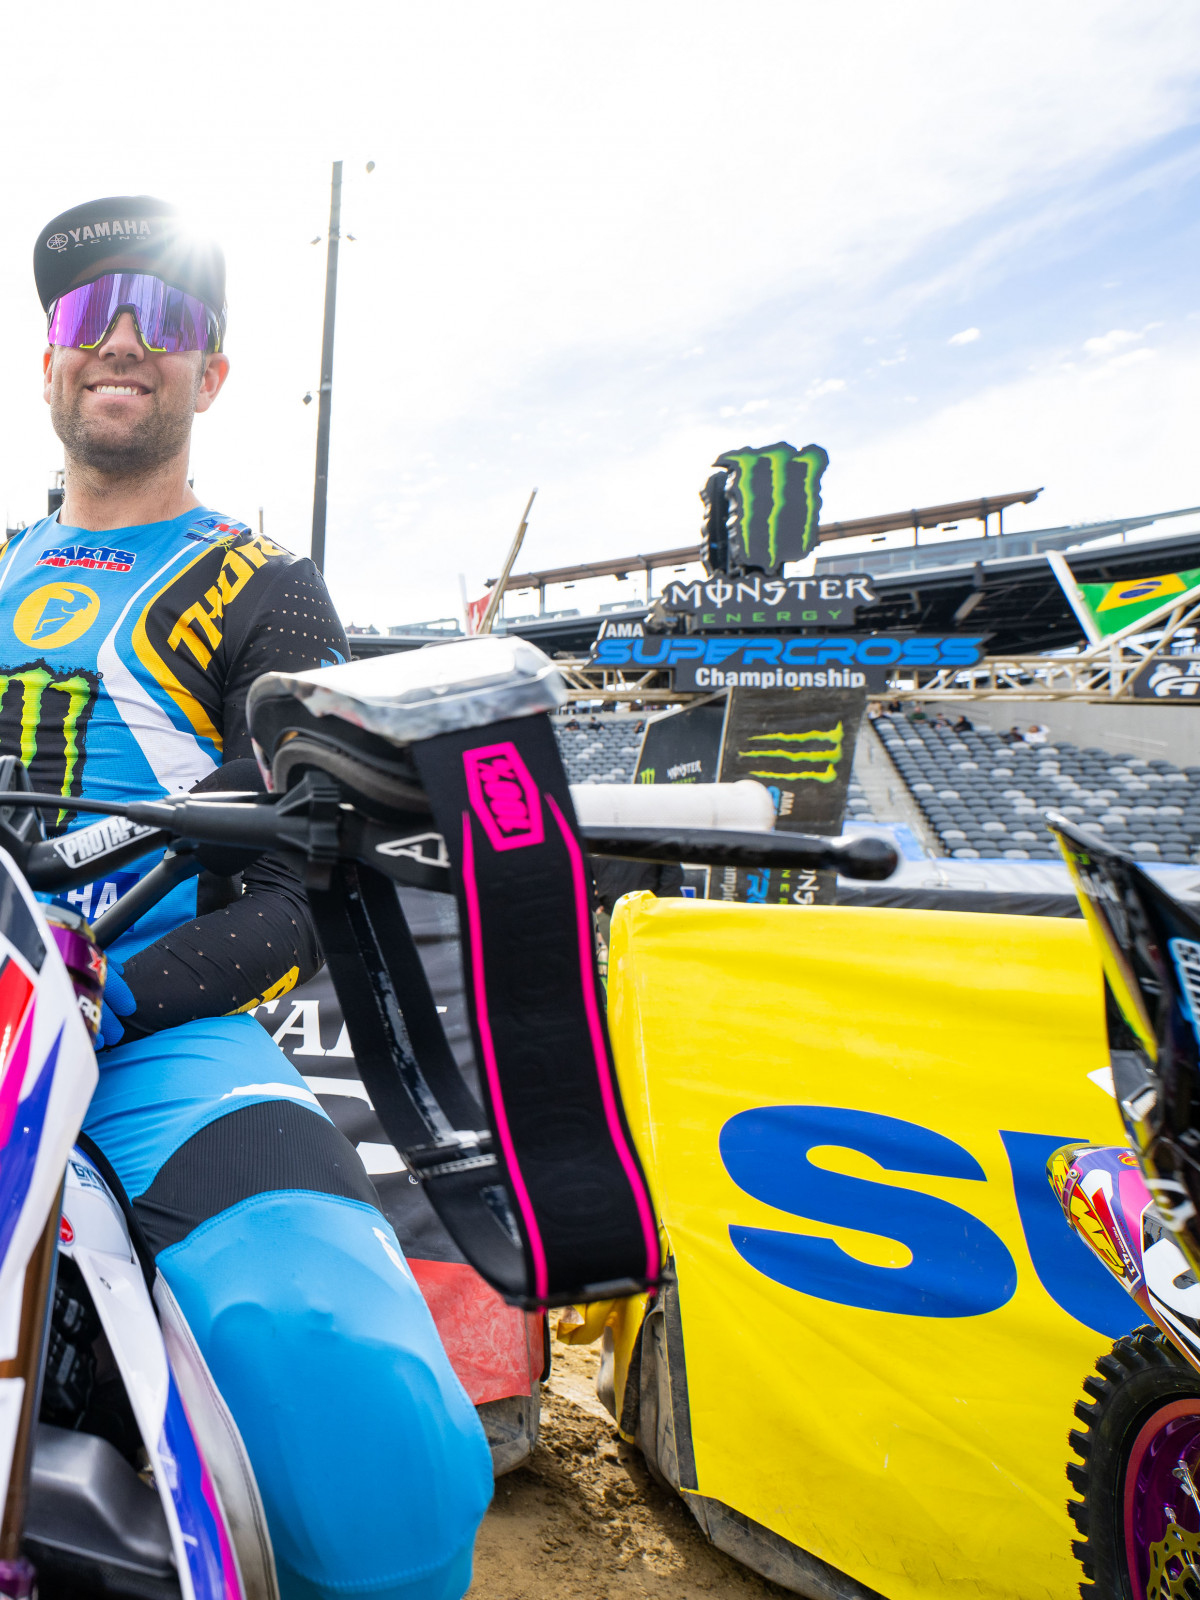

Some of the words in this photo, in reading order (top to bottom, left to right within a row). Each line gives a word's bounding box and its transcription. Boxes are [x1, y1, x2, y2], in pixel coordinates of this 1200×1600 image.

[69, 220, 152, 243] YAMAHA
[57, 234, 147, 253] RACING
[35, 557, 133, 573] UNLIMITED
[39, 545, 137, 565] PARTS
[167, 533, 288, 671] THOR
[672, 577, 876, 608] MONSTER
[703, 609, 844, 625] ENERGY
[605, 623, 645, 638] AMA
[594, 637, 985, 666] SUPERCROSS
[695, 667, 866, 689] Championship
